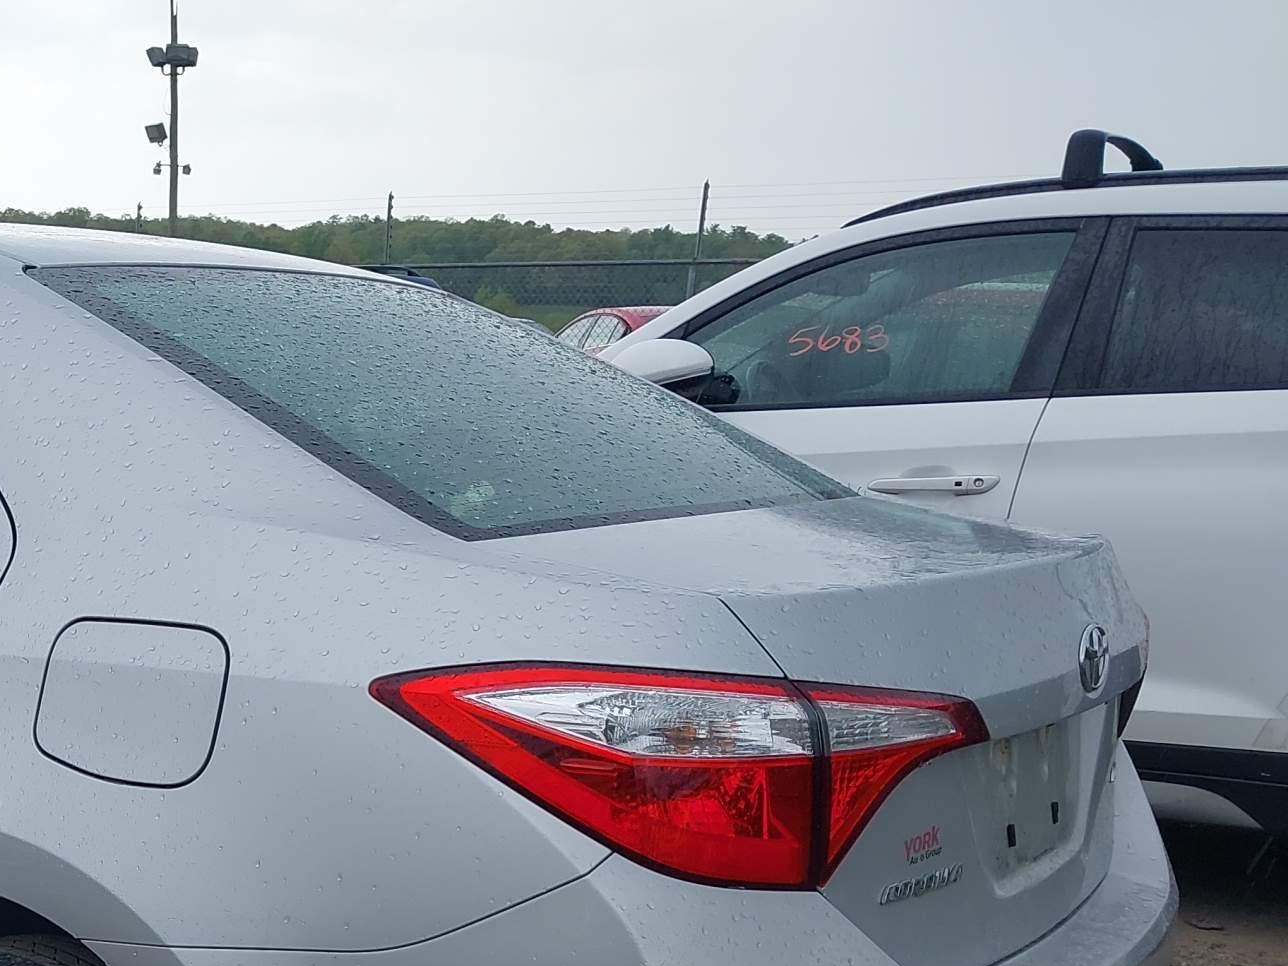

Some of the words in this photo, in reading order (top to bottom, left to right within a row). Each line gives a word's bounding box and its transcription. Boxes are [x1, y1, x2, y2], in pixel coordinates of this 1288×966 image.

[788, 322, 890, 357] 5683
[904, 824, 942, 862] YORK
[909, 853, 925, 865] Auo
